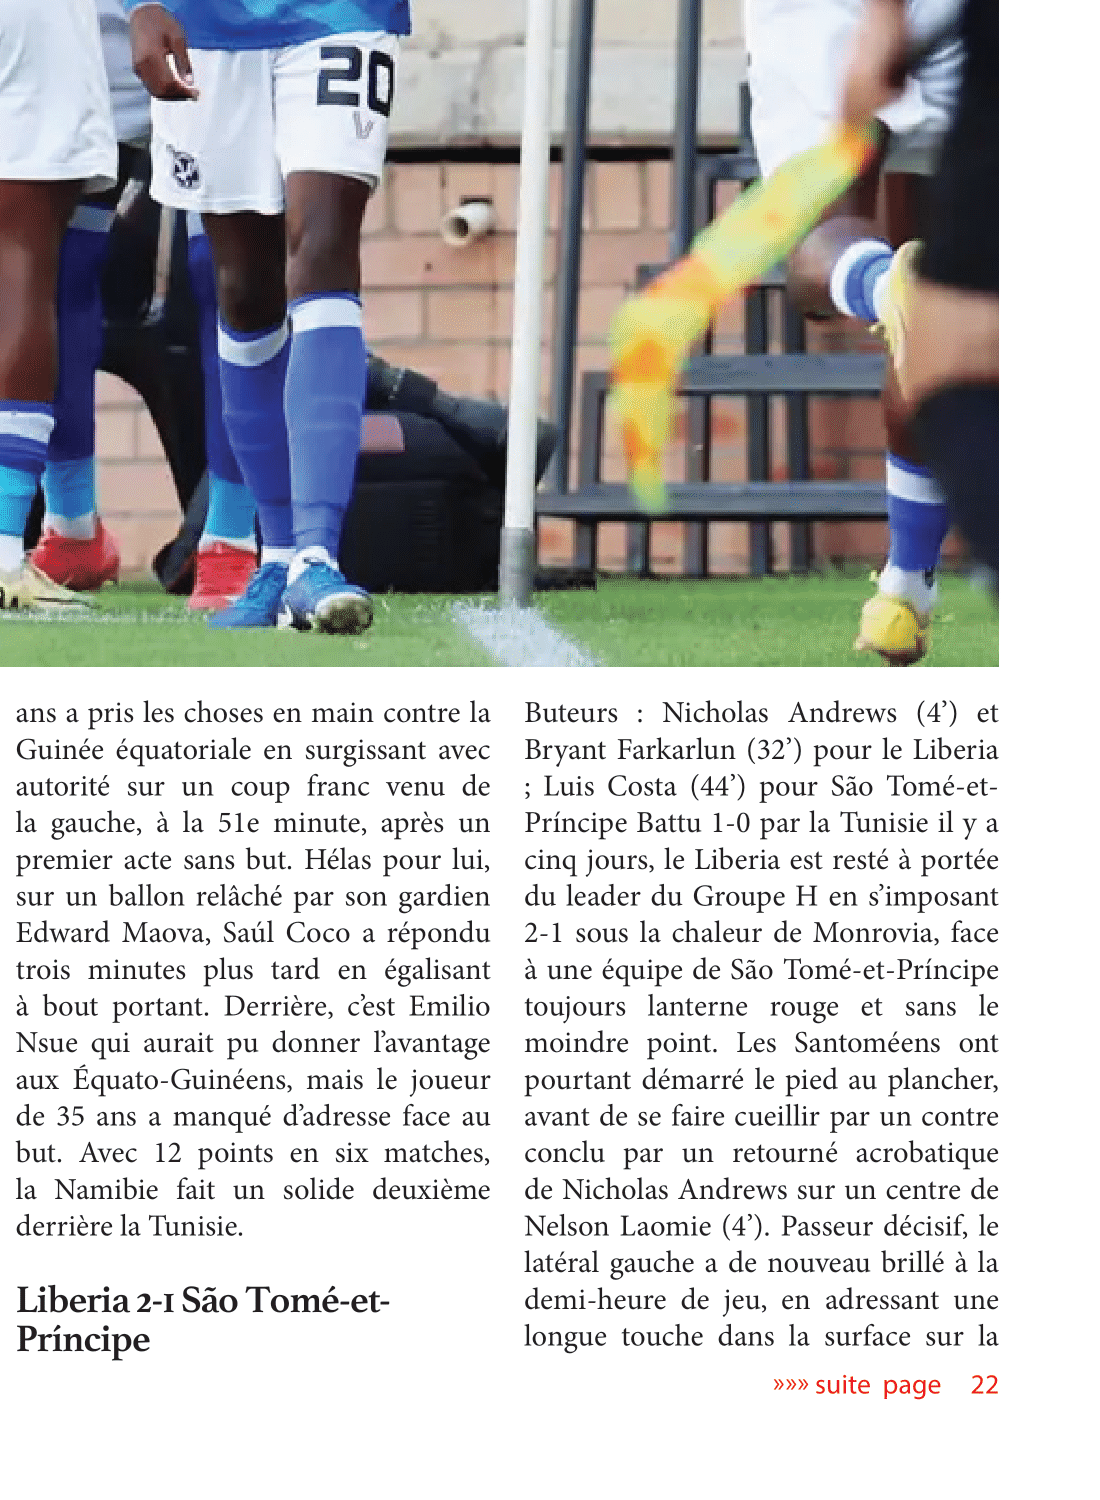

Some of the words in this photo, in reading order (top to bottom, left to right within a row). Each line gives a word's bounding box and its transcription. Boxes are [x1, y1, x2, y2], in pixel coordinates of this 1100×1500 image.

[316, 45, 396, 119] 20
[16, 737, 104, 760] Guinée
[116, 736, 252, 767] équatoriale
[263, 744, 293, 760] en
[305, 739, 427, 768] surgissant
[438, 744, 491, 760] avec
[524, 738, 607, 768] Bryant
[617, 736, 736, 760] Farkarlun
[813, 744, 872, 767] pour
[881, 736, 903, 760] le
[913, 736, 1000, 760] Liberia
[15, 849, 113, 877] premier
[124, 851, 172, 870] acte
[183, 854, 235, 870] sans
[245, 846, 292, 870] but.
[304, 847, 372, 870] Hélas
[382, 854, 442, 877] pour
[451, 846, 490, 873] lui,
[524, 883, 557, 907] du
[566, 883, 642, 907] leader
[651, 883, 683, 907] du
[693, 884, 786, 914] Groupe
[795, 885, 818, 907] H
[829, 891, 858, 907] en
[15, 959, 71, 980] trois
[87, 959, 186, 980] minutes
[203, 956, 254, 987] plus
[270, 956, 321, 980] tard
[338, 964, 367, 980] en
[384, 956, 491, 988] égalisant
[524, 1029, 629, 1053] moindre
[646, 1032, 718, 1060] point.
[736, 1031, 777, 1053] Les
[794, 1030, 941, 1053] Santoméens
[959, 1034, 999, 1053] ont
[16, 1074, 60, 1090] aux
[72, 1063, 293, 1097] Équato-Guinéens,
[306, 1069, 364, 1090] mais
[376, 1067, 398, 1090] le
[409, 1069, 491, 1098] joueur
[524, 1213, 610, 1237] Nelson
[620, 1215, 712, 1237] Laomie
[781, 1215, 874, 1237] Passeur
[883, 1213, 968, 1240] décisif,
[978, 1213, 999, 1237] le
[16, 1284, 131, 1313] Liberia
[136, 1292, 175, 1313] 2-1
[182, 1285, 239, 1313] São
[245, 1285, 390, 1313] Tomé-et-
[16, 1324, 151, 1362] Príncipe
[524, 1323, 607, 1354] longue
[621, 1323, 704, 1347] touche
[718, 1323, 775, 1347] dans
[788, 1323, 810, 1347] la
[824, 1323, 911, 1347] surface
[925, 1331, 965, 1347] sur
[978, 1323, 999, 1347] la
[815, 1374, 871, 1395] suite
[883, 1379, 942, 1400] page
[971, 1374, 999, 1395] 22
